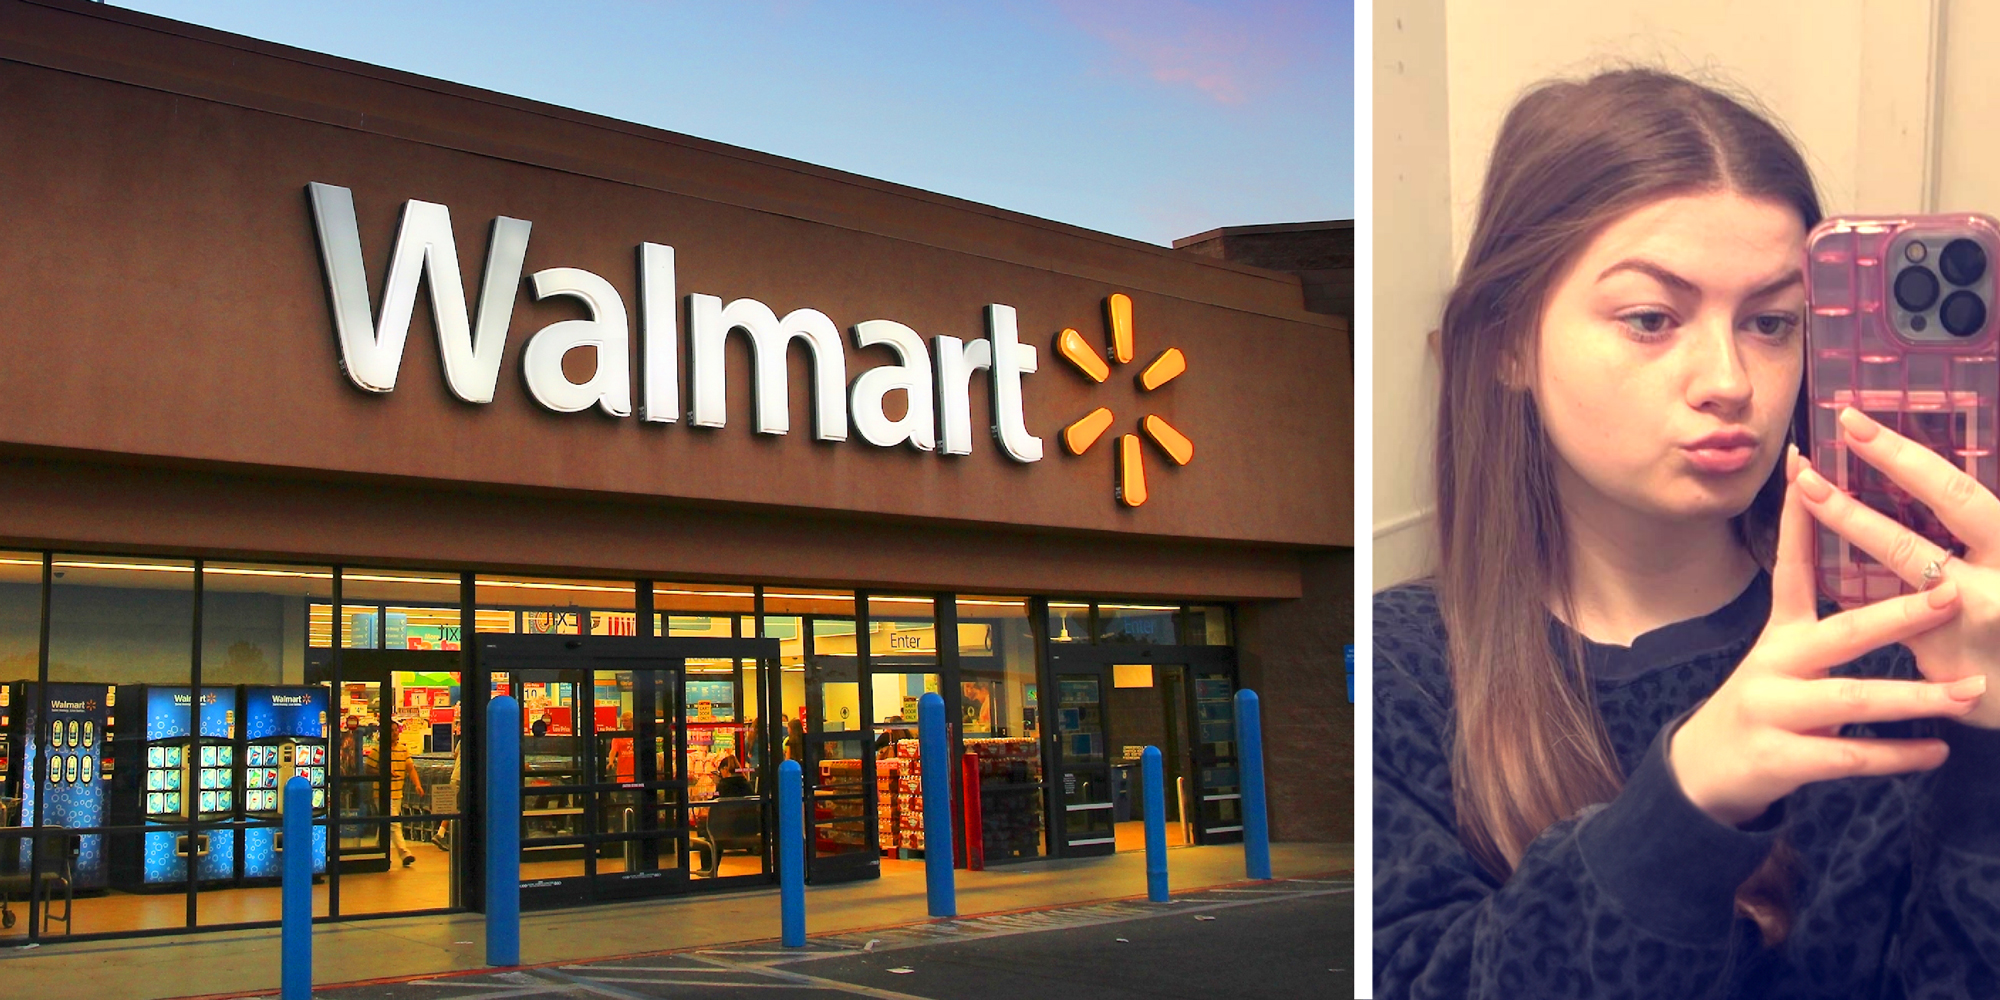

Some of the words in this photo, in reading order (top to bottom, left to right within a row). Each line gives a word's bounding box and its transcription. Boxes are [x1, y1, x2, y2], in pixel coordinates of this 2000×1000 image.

[306, 181, 1044, 463] Walmart
[1124, 616, 1155, 634] Enter
[890, 633, 921, 649] Enter
[51, 700, 86, 709] Walmart
[174, 694, 207, 703] Walrt
[272, 694, 302, 703] Walmart
